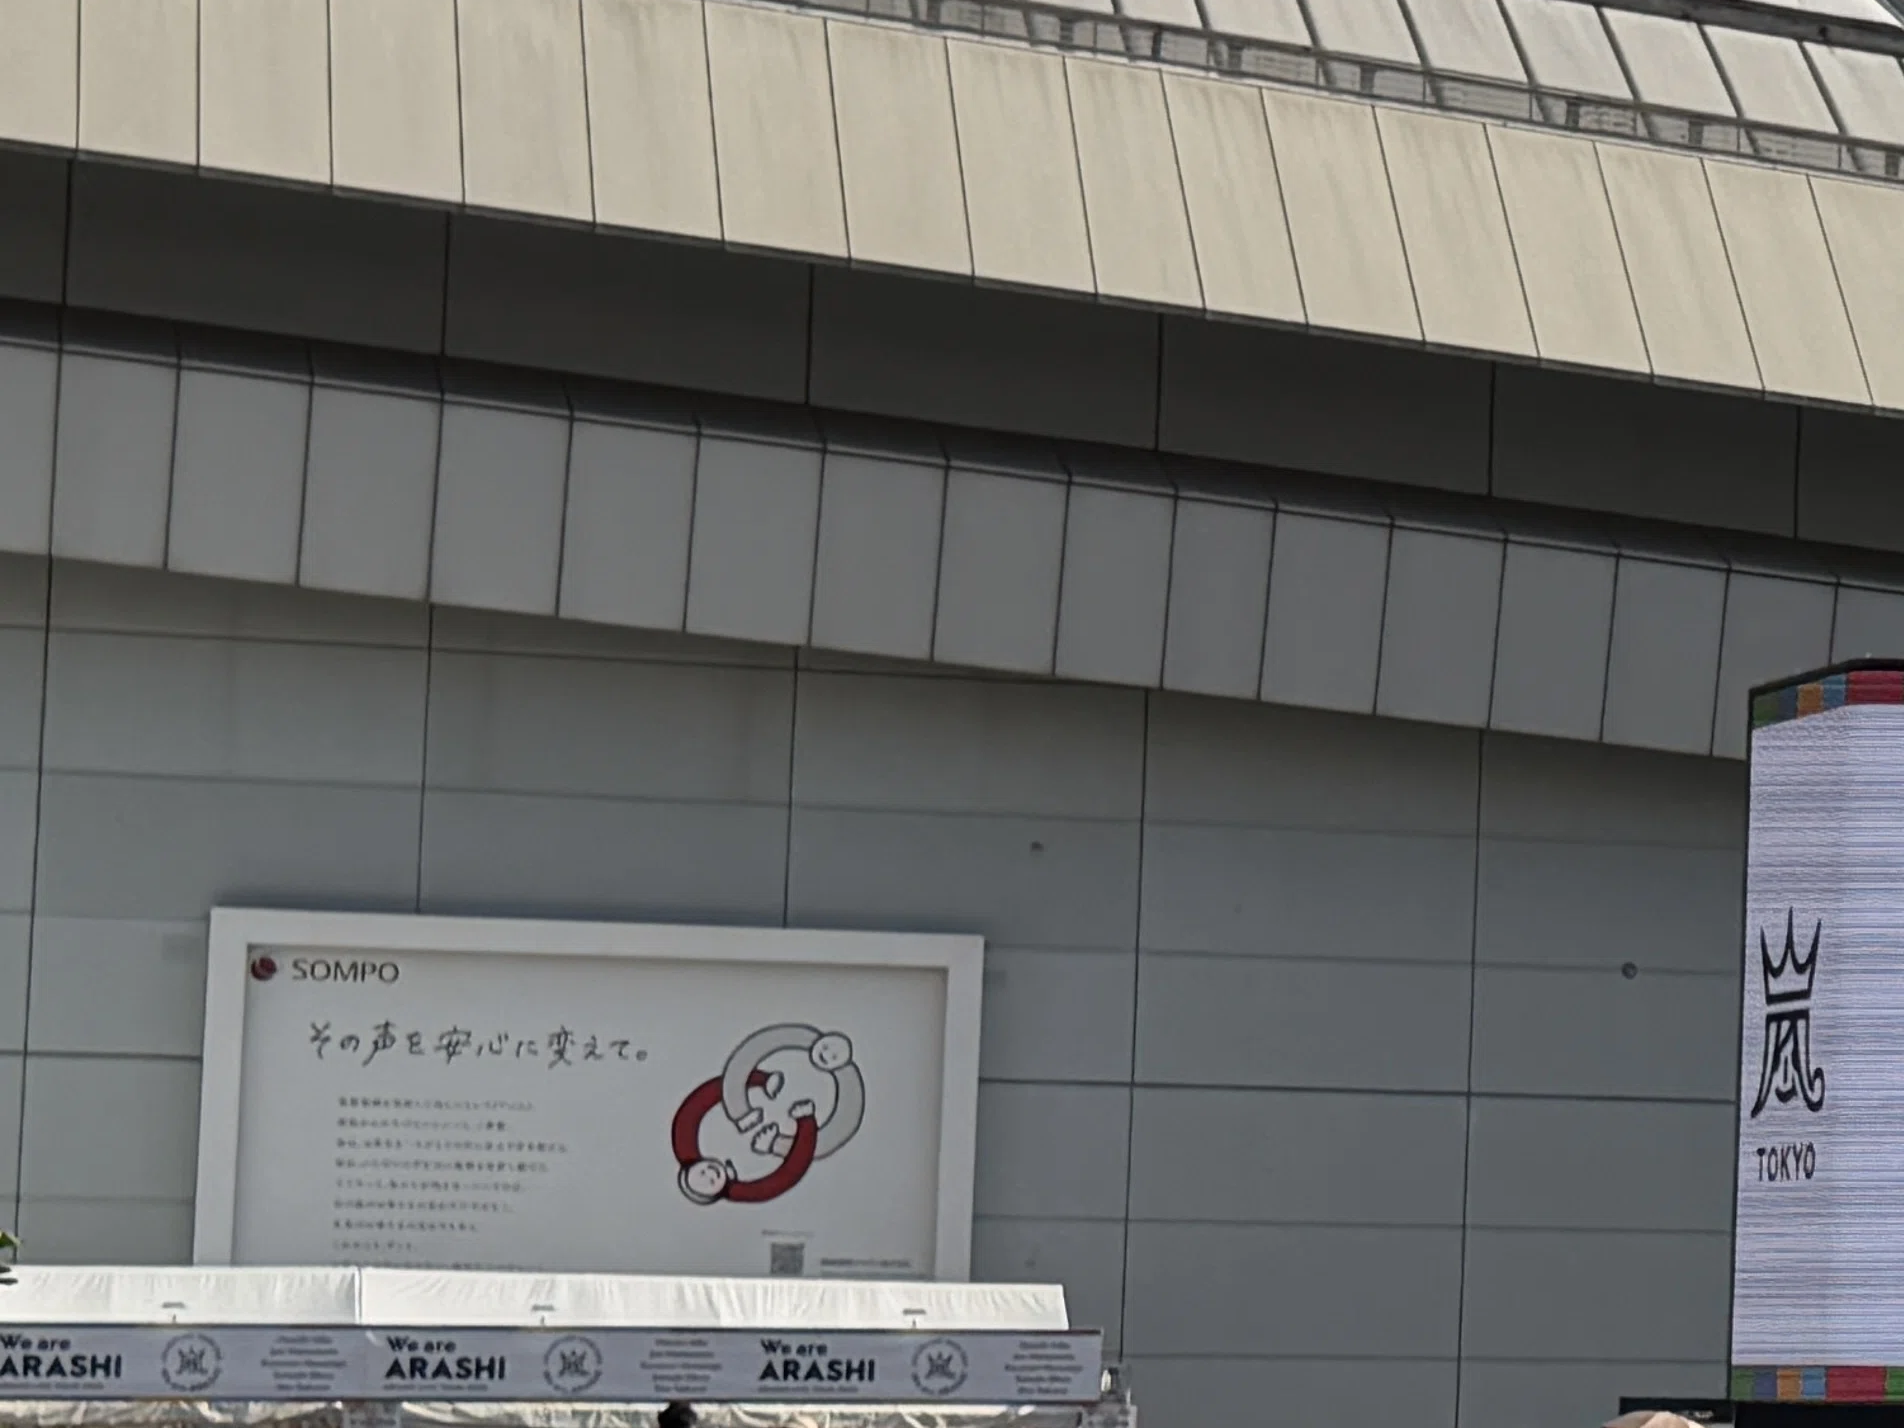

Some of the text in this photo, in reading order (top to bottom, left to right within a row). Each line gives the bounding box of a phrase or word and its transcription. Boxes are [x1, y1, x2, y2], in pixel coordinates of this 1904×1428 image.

[291, 957, 401, 984] SOMPO
[309, 1020, 649, 1068] その声を安心に変えて。
[1755, 1141, 1817, 1183] TOKYO
[0, 1334, 71, 1351] We are
[386, 1336, 456, 1354] We are
[759, 1338, 828, 1357] We are
[0, 1355, 122, 1378] ARASHI
[384, 1356, 506, 1380] ARASHI
[759, 1358, 875, 1382] ARASHI
